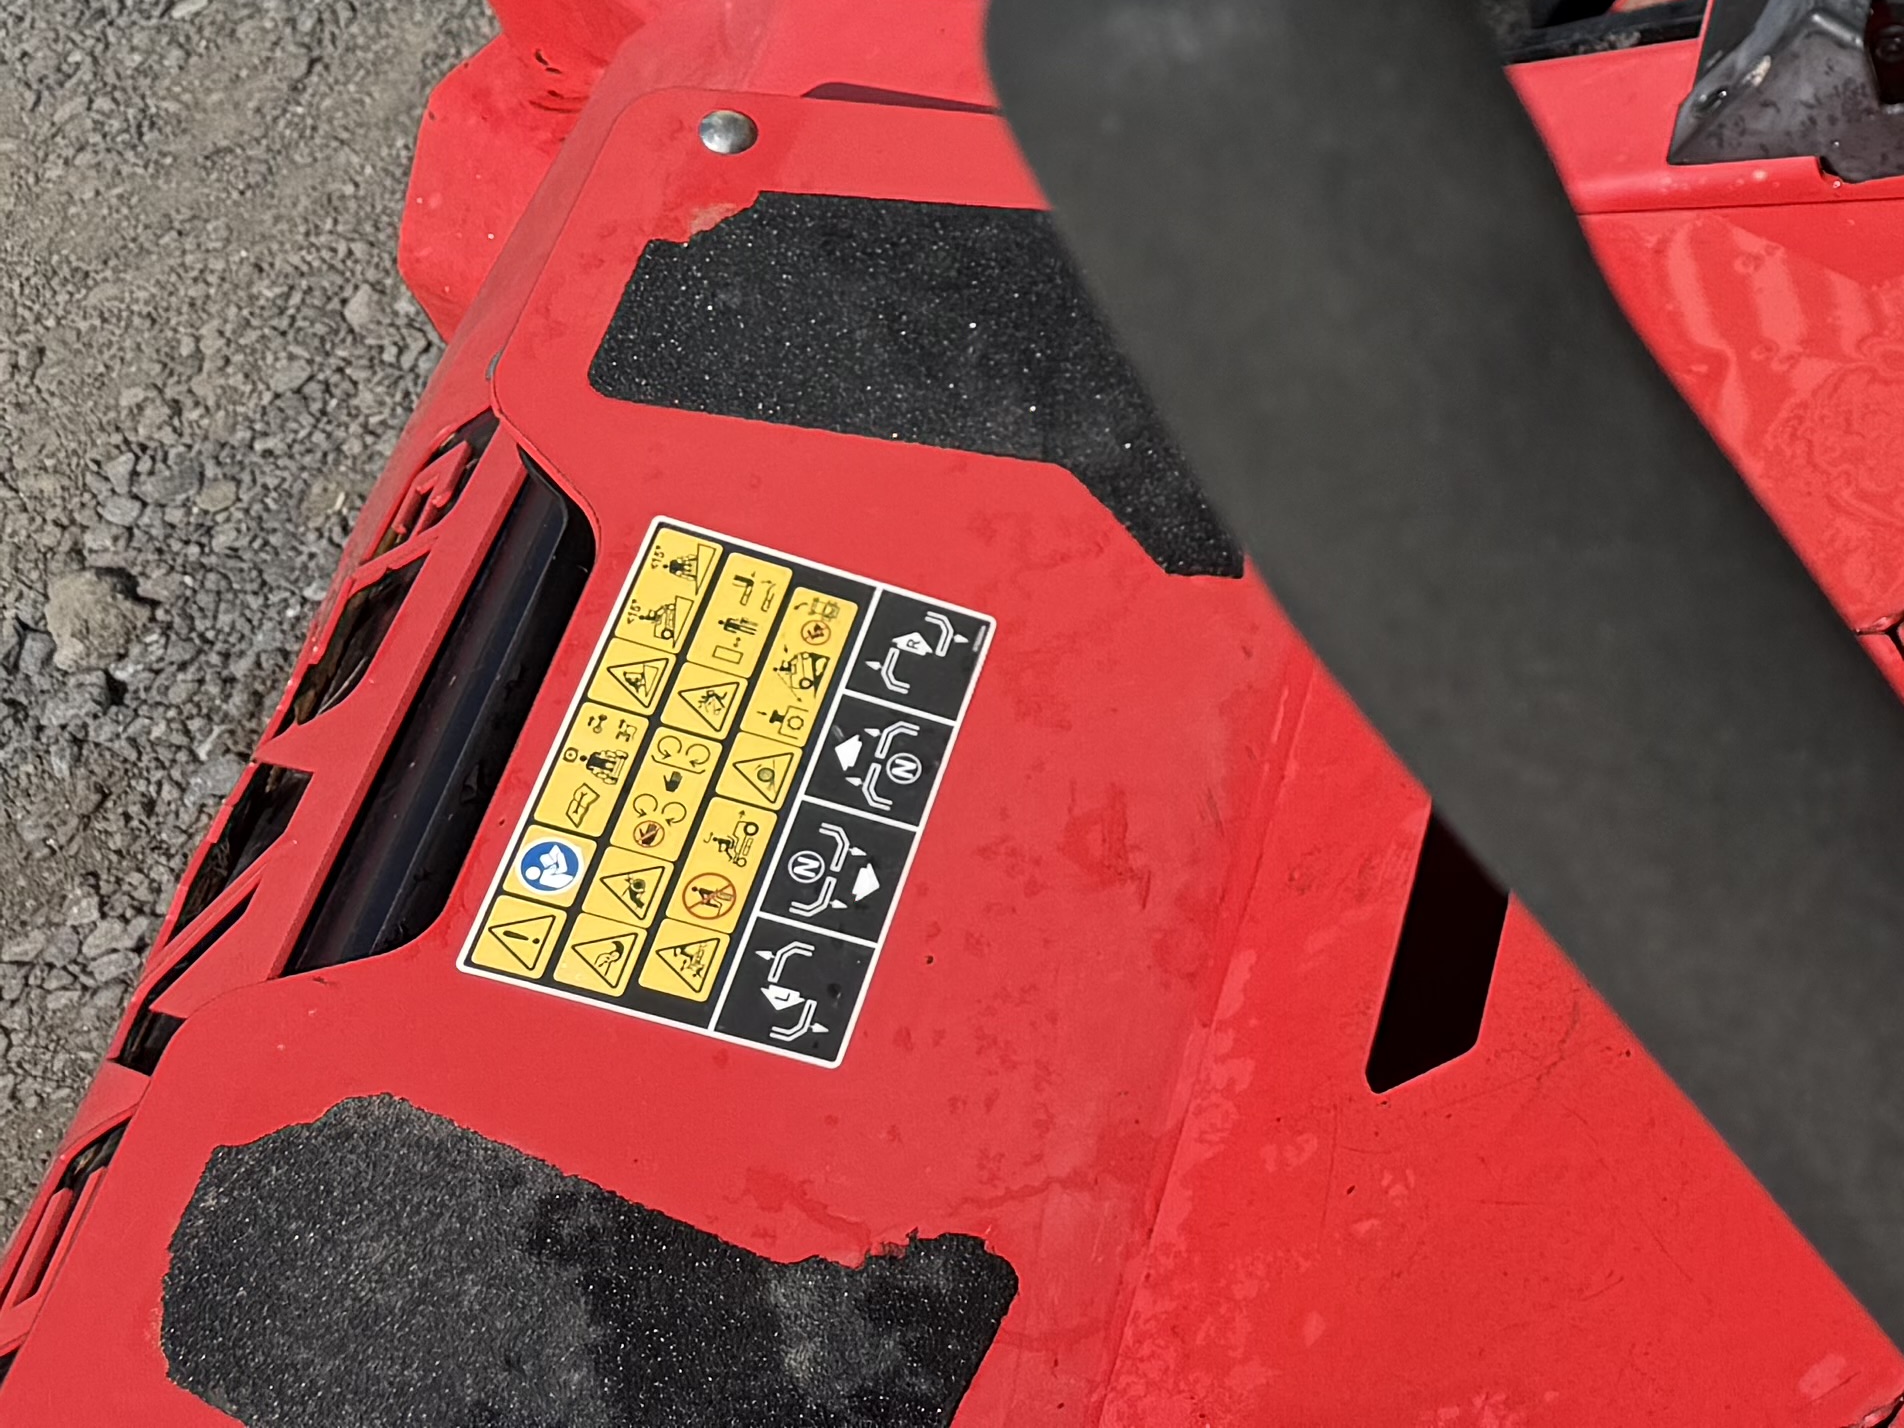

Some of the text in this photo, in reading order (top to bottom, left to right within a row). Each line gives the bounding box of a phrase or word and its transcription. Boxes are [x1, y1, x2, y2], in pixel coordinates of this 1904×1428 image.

[906, 638, 921, 650] R
[891, 758, 917, 779] N
[793, 856, 820, 878] N
